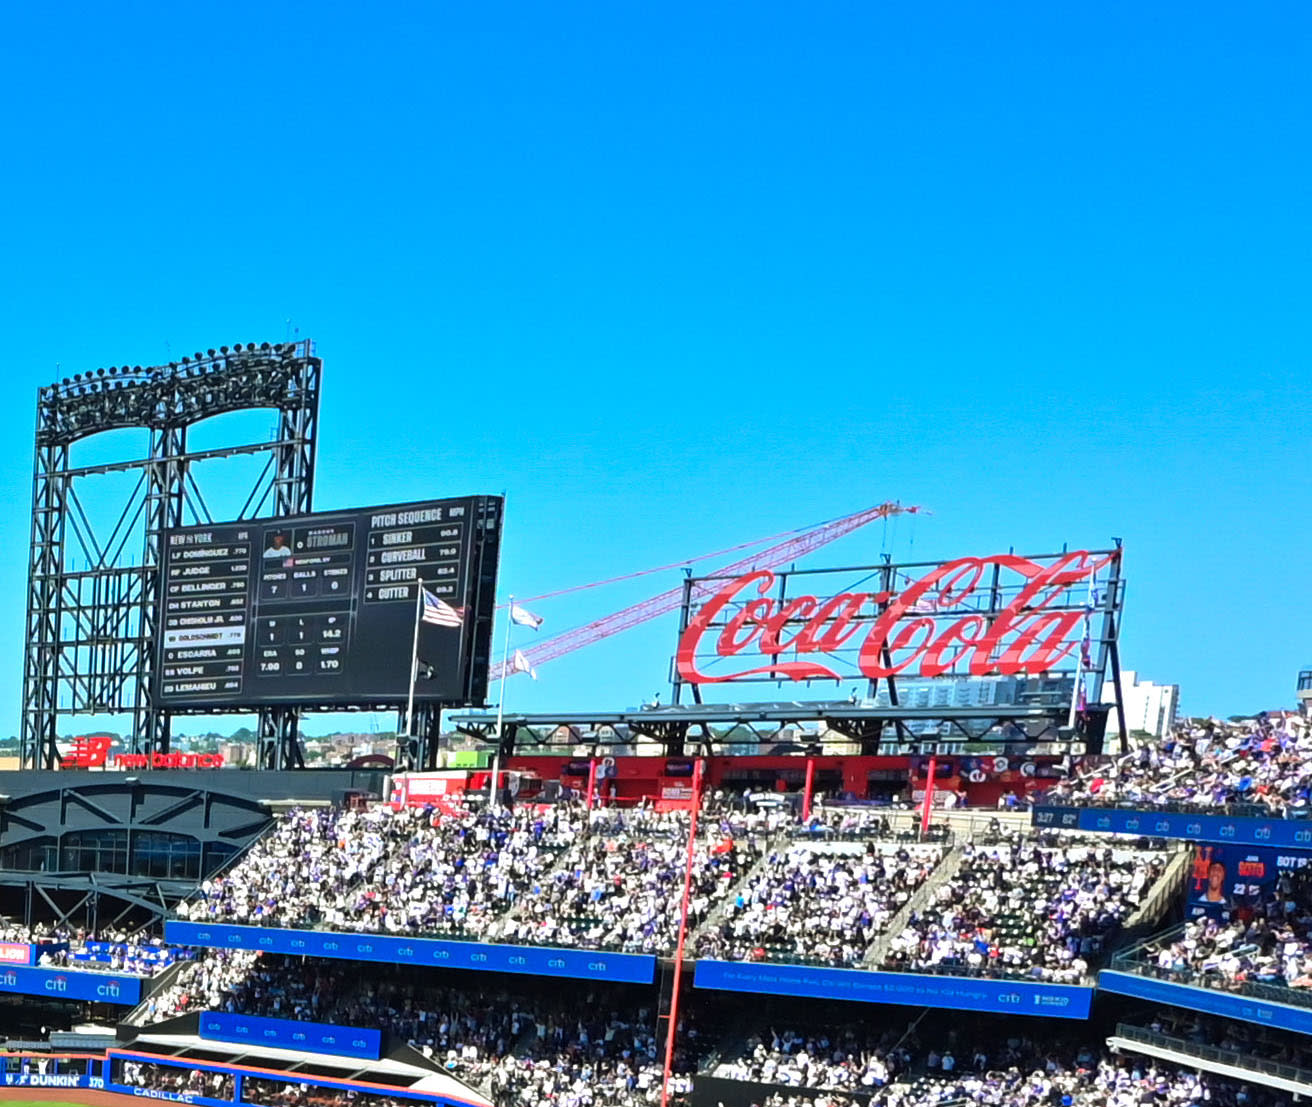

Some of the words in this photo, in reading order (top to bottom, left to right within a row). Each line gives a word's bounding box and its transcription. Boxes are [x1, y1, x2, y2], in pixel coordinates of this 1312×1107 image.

[371, 514, 396, 528] PITCH
[398, 508, 442, 524] SEQUENCE
[380, 568, 417, 581] SPLITTER
[379, 587, 409, 599] CUTTER
[152, 750, 224, 768] balance
[30, 1075, 80, 1087] DUNKIN'
[134, 1088, 193, 1104] CADILLAC
